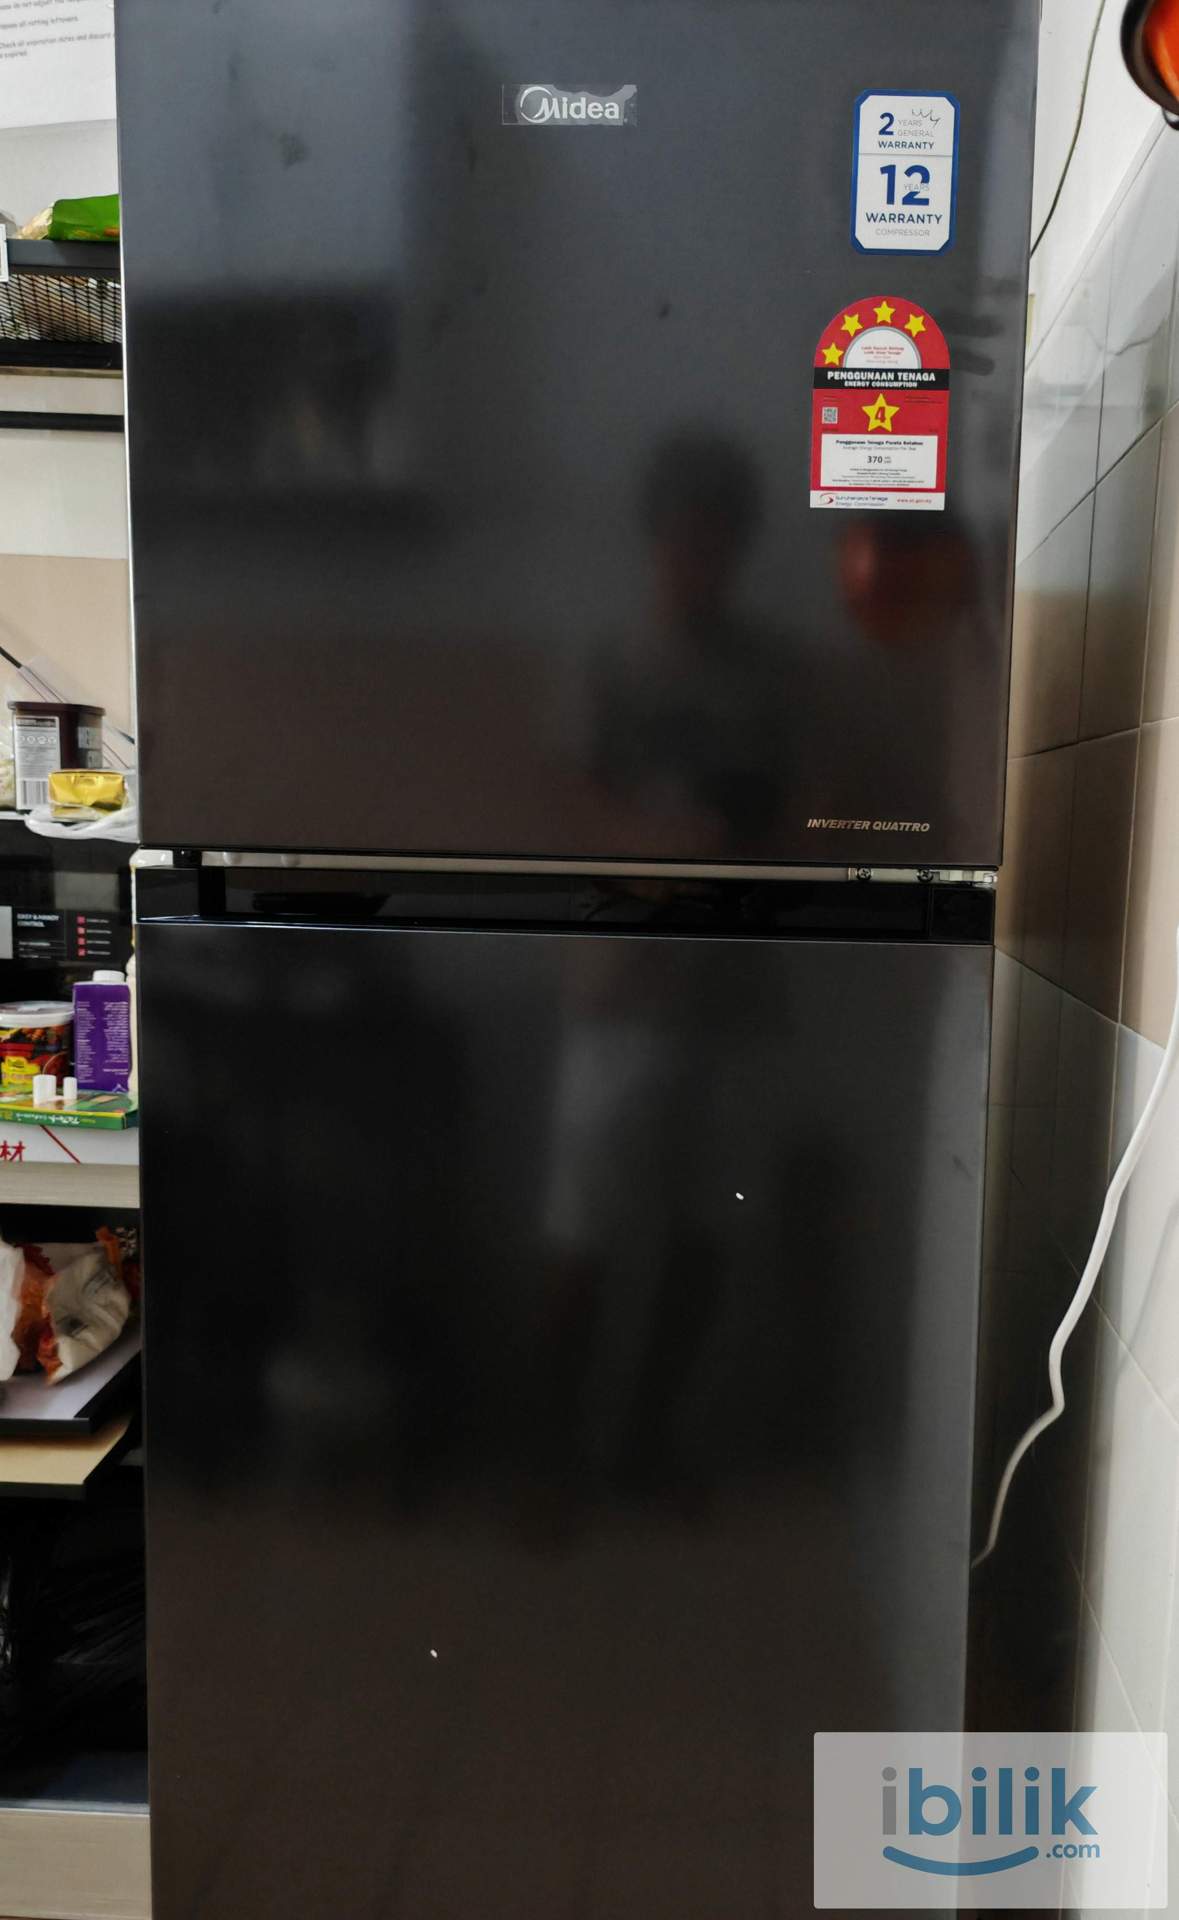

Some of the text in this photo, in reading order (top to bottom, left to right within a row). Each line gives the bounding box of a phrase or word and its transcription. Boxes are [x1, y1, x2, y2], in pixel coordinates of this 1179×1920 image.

[520, 88, 620, 123] Midea
[878, 112, 895, 136] 2
[898, 119, 923, 127] YEARS
[897, 130, 934, 138] GENERAL
[878, 141, 935, 150] WARRANTY
[879, 164, 931, 206] 12
[865, 212, 943, 225] WARRANTY
[875, 228, 931, 237] COMPRESSOR
[827, 371, 936, 382] PENGGUNAAN TENAGA
[875, 406, 887, 424] 4
[867, 456, 883, 464] 370
[807, 819, 930, 832] INVERTER QUATTRO
